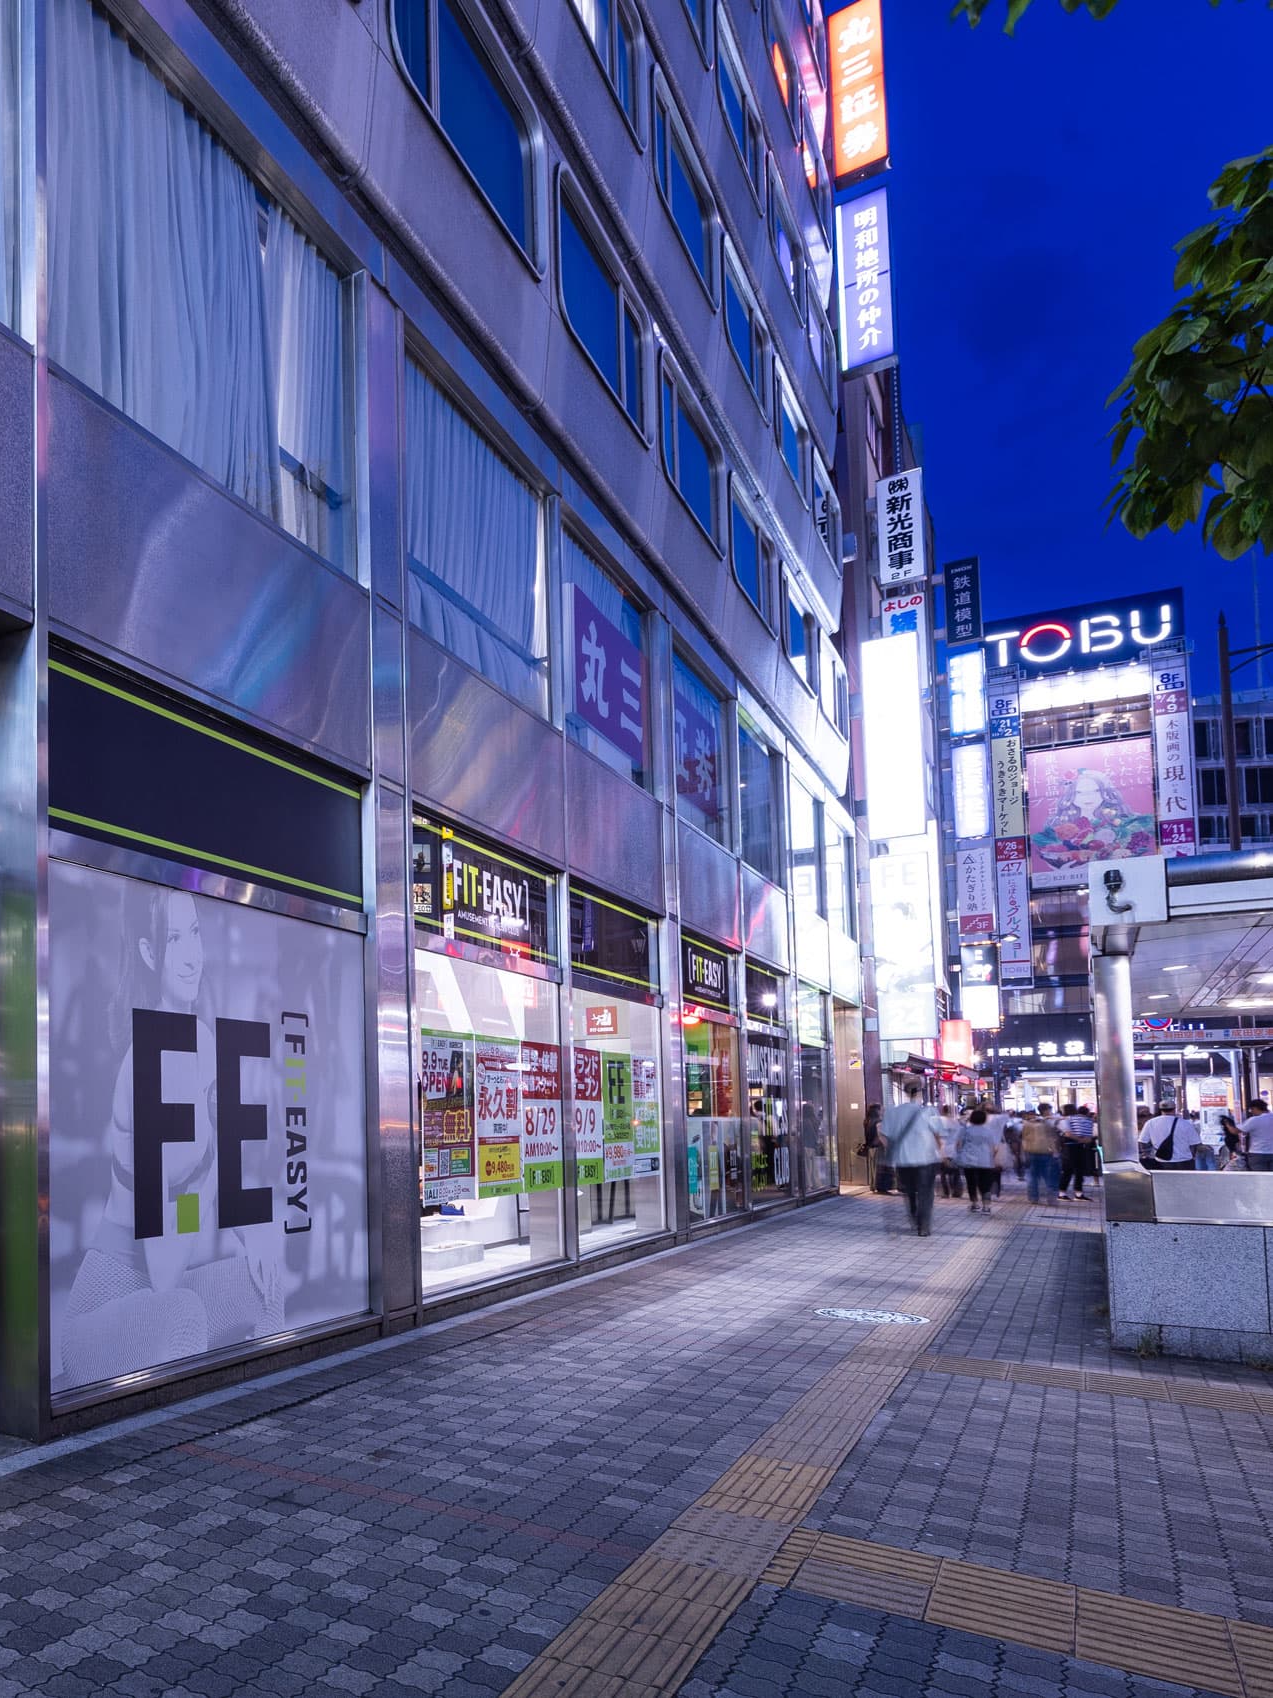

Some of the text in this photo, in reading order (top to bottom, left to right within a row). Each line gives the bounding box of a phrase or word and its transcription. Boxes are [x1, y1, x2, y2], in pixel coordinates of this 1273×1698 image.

[854, 206, 882, 350] 明和地所の仲介
[891, 569, 912, 580] 2F
[884, 595, 922, 612] よしの
[953, 576, 973, 639] 鉄道模型
[984, 604, 1171, 667] TOBU
[1159, 673, 1180, 684] 8F
[995, 699, 1013, 710] 8F
[1006, 739, 1019, 806] おさるのジョージ
[997, 760, 1010, 837] うきうきマーケット
[976, 920, 989, 929] 3F
[438, 1058, 449, 1071] TUE
[574, 1051, 598, 1074] ランド
[574, 1075, 599, 1098] ープン
[478, 1085, 518, 1121] 永久割
[525, 1106, 556, 1137] 8/29
[576, 1106, 596, 1136] 9/9
